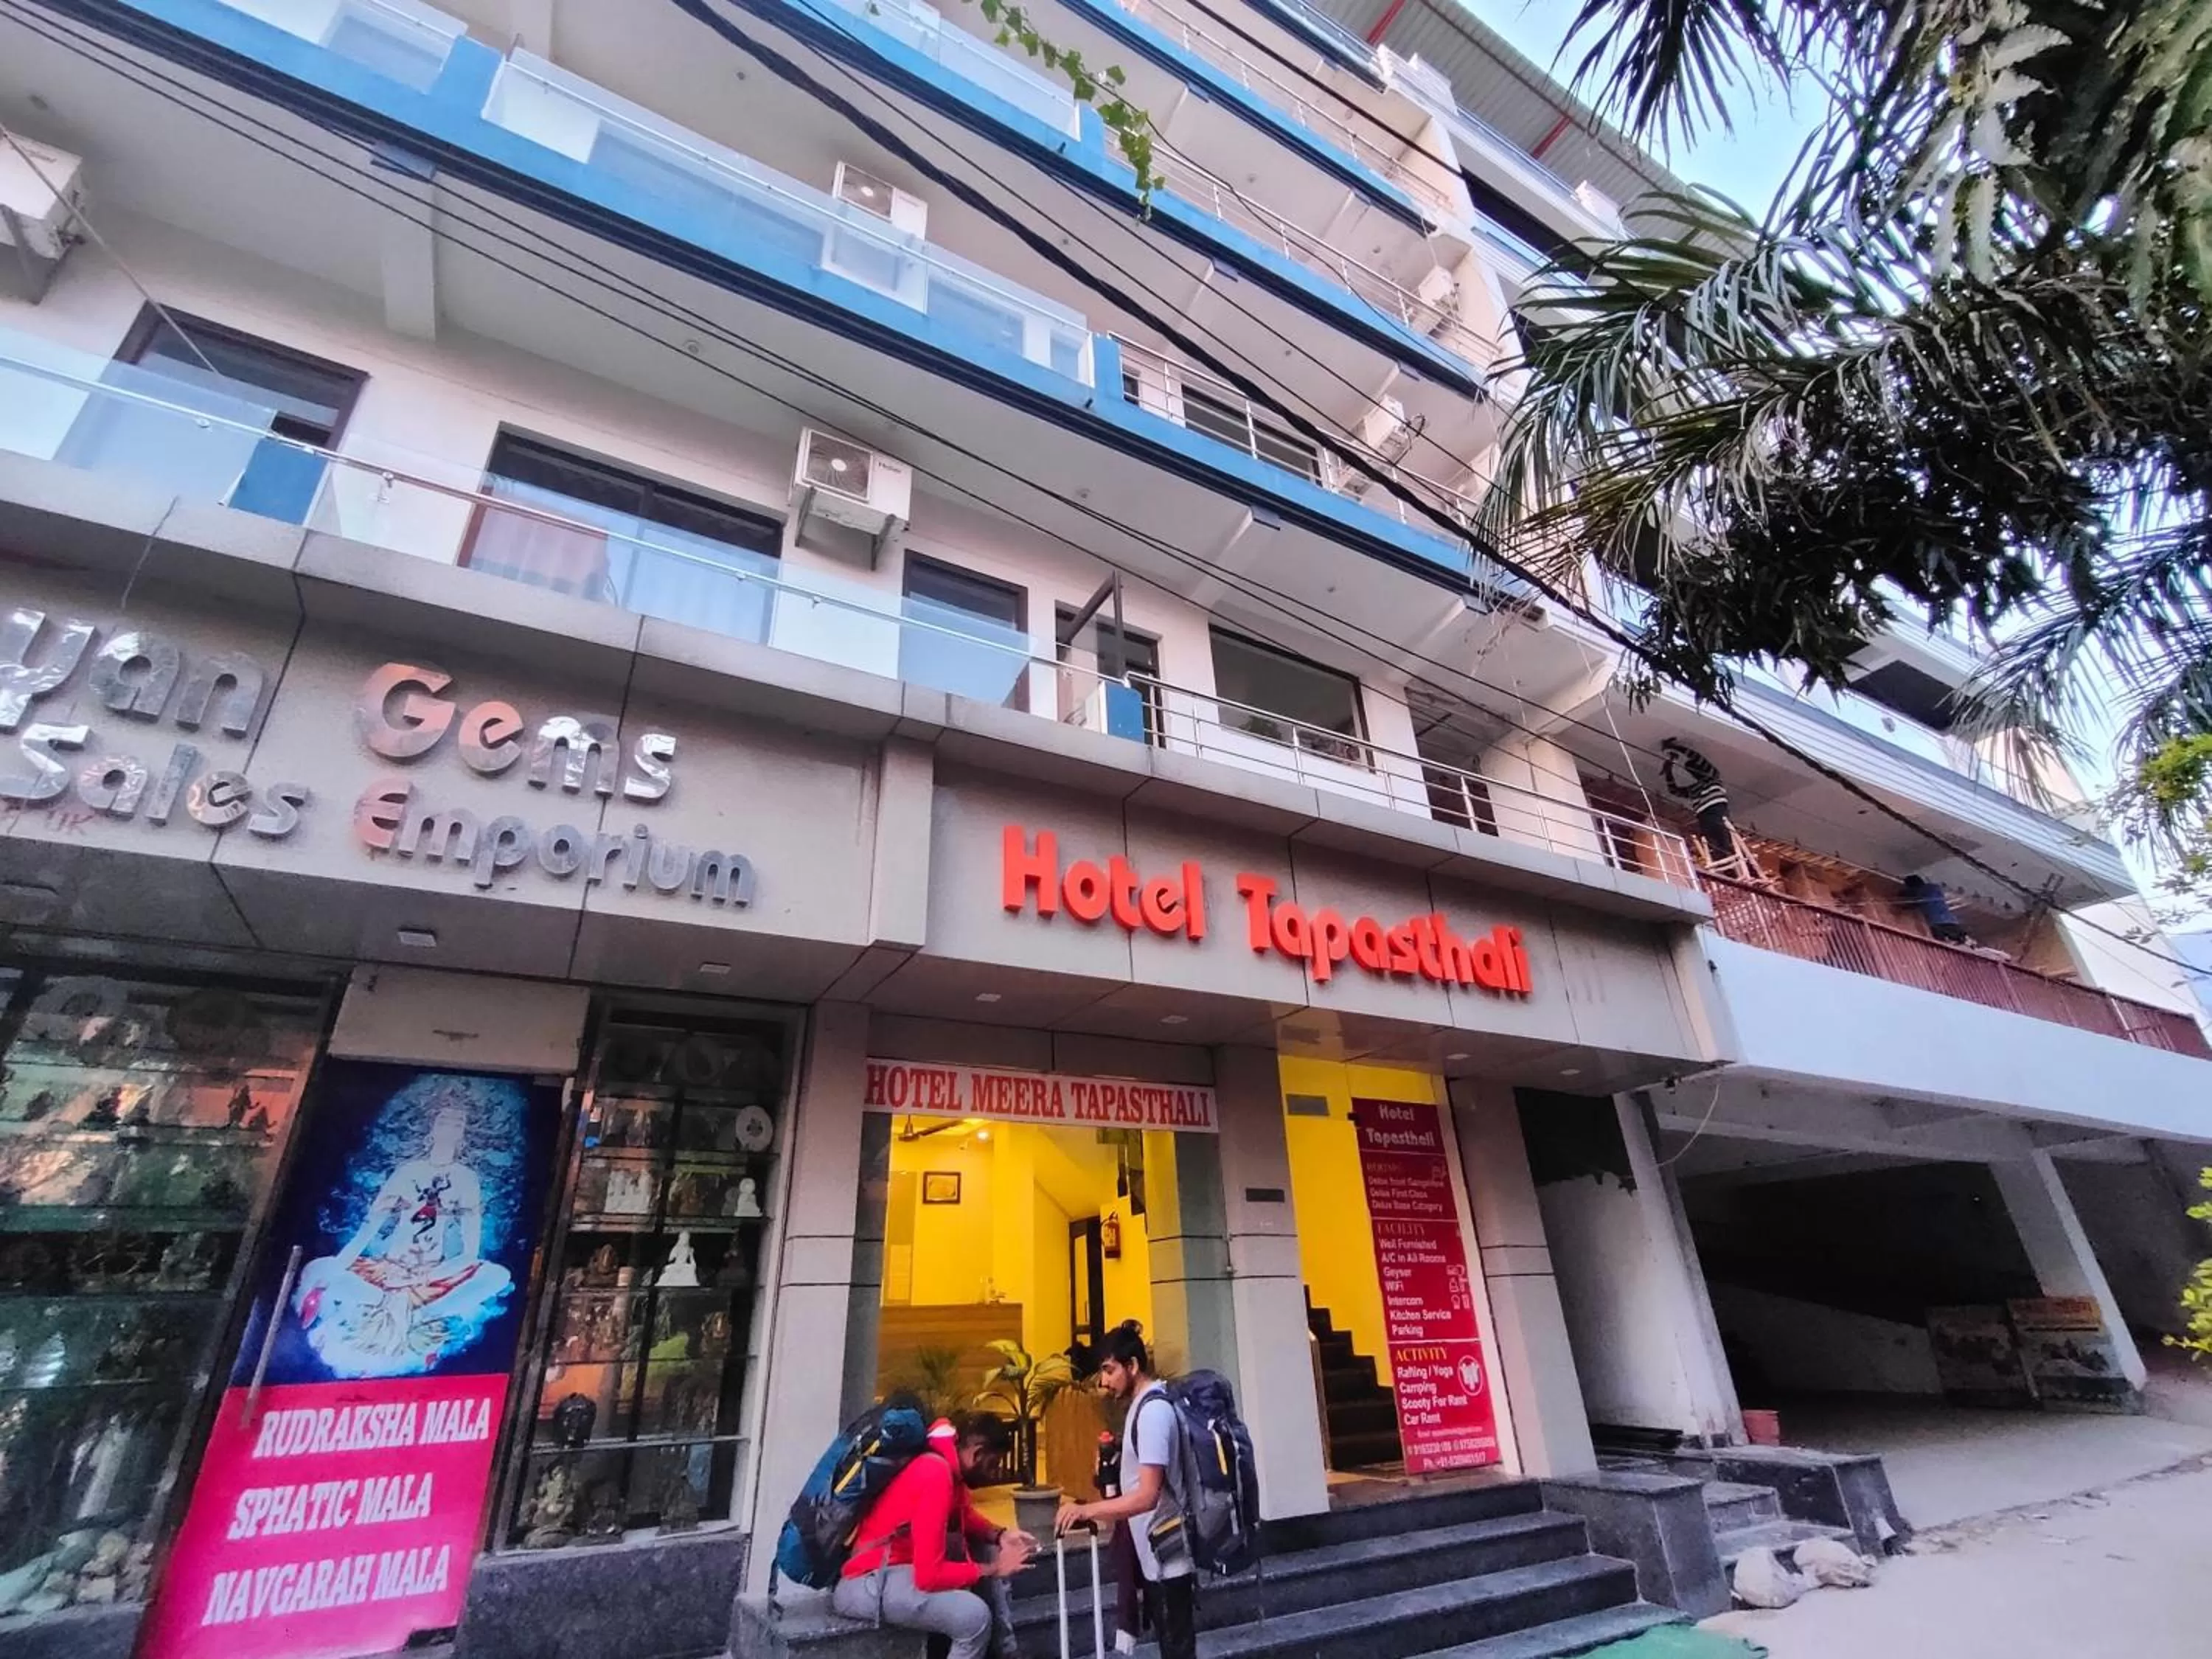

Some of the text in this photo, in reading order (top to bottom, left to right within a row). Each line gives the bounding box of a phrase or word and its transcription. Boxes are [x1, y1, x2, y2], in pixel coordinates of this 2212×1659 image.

[355, 660, 678, 804] Gems
[0, 723, 758, 908] Sales Emporium
[1002, 824, 1533, 995] Hotel Tapasthali
[865, 1063, 1211, 1127] HOTEL MEERA TAPASTHALI
[1379, 1103, 1415, 1121] Hotel
[1381, 1251, 1396, 1263] A/C
[1387, 1294, 1424, 1307] Intercom
[1389, 1309, 1452, 1321] Kitchen Service
[1391, 1324, 1424, 1338] Parking
[1396, 1346, 1447, 1363] ACTIVITY
[1397, 1366, 1428, 1380] Rafting
[1433, 1364, 1454, 1379] Yoga
[1399, 1381, 1437, 1396] Camping
[1431, 1394, 1447, 1408] For
[1403, 1411, 1441, 1426] Car Rent
[252, 1398, 492, 1459] RUDRAKSHA MALA
[226, 1472, 434, 1541] SPHATIC MALA
[372, 1544, 450, 1601] MALA
